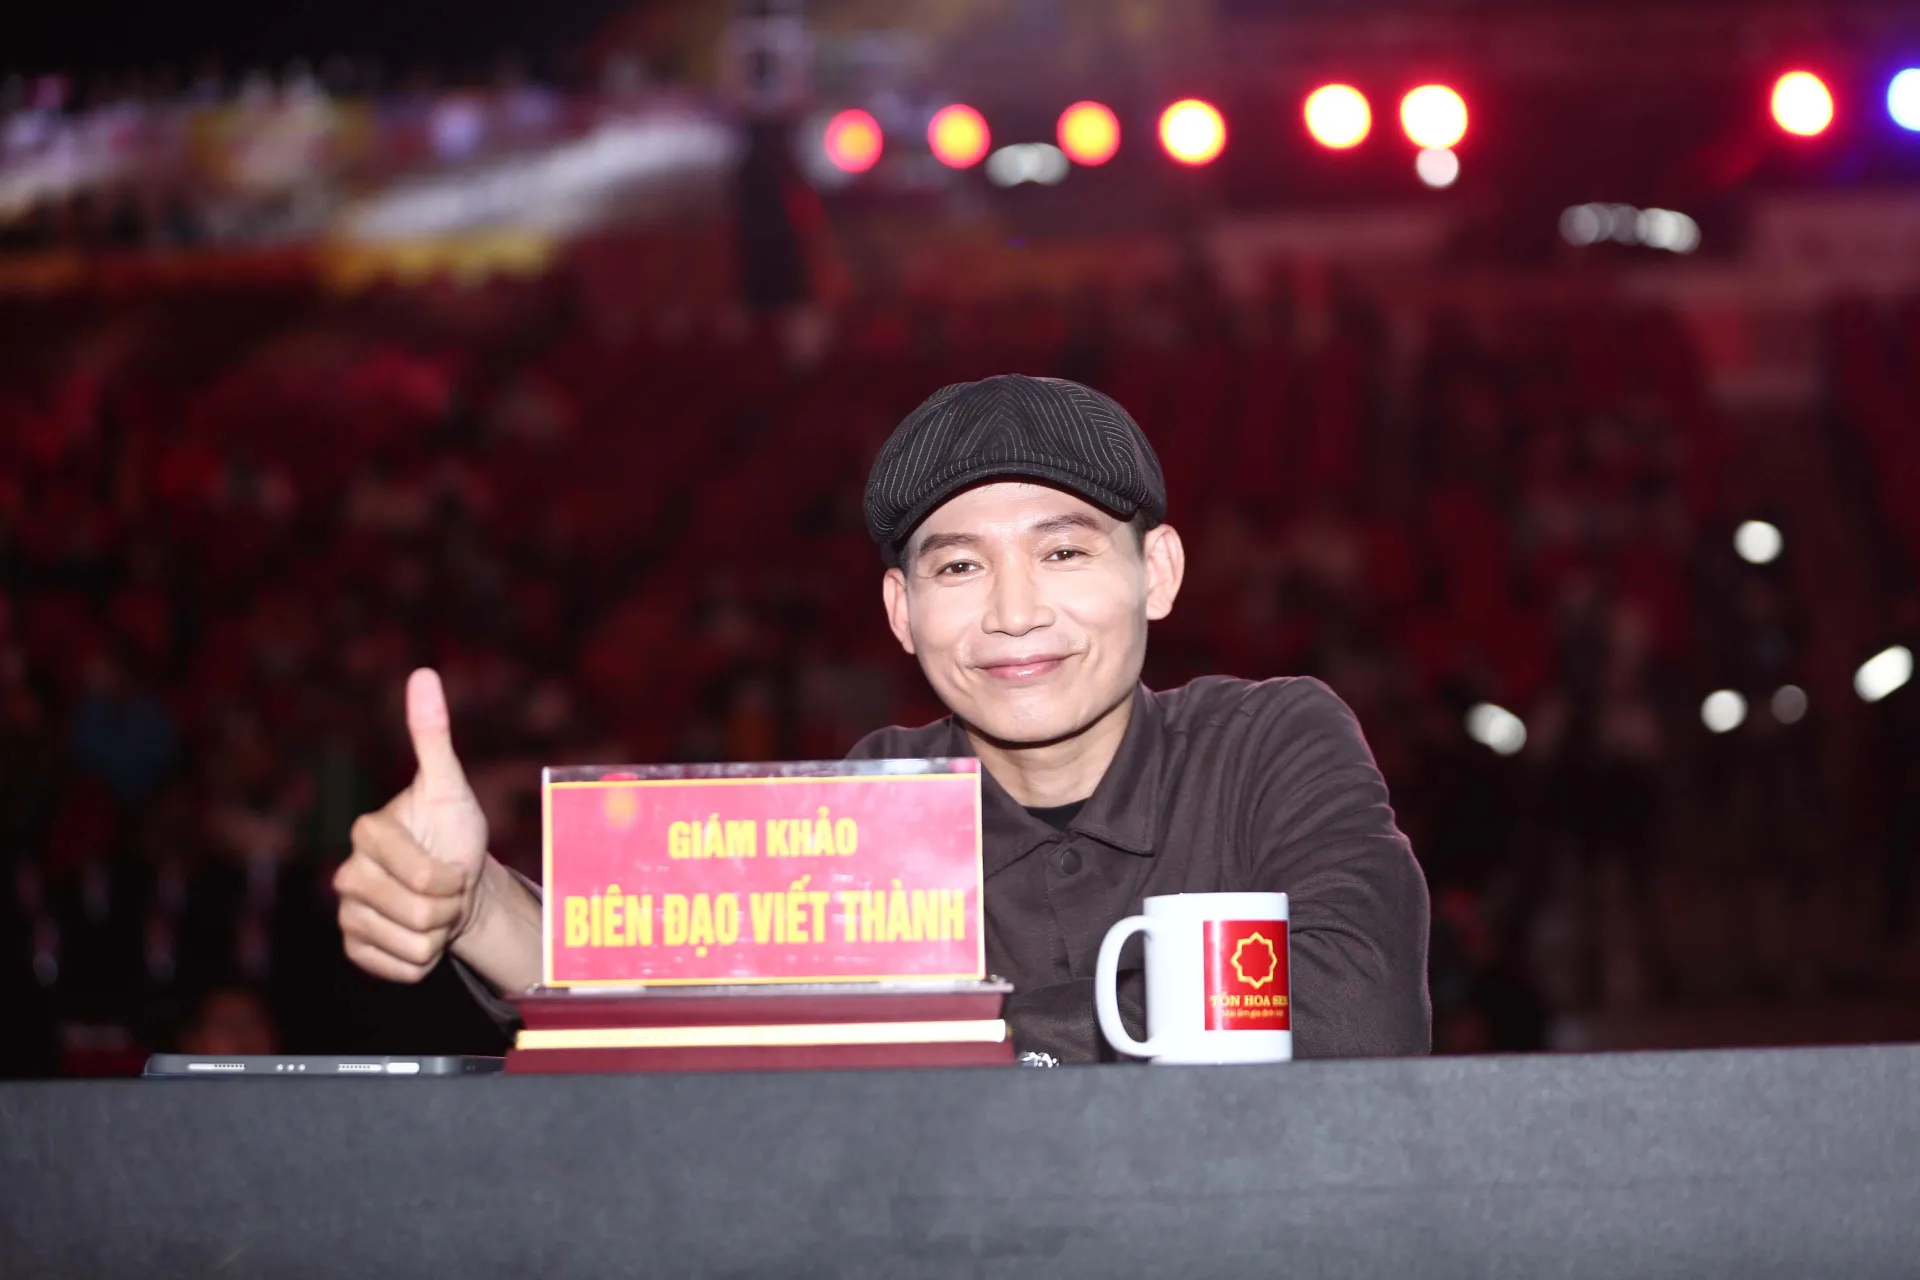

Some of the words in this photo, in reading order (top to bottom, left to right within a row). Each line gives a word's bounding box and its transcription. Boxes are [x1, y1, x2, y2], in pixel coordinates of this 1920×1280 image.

[668, 813, 757, 860] GIÁM
[766, 806, 858, 857] KHẢO
[565, 884, 653, 948] BIÊN
[663, 894, 740, 958] ĐẠO
[749, 875, 830, 944] VIẾT
[838, 878, 966, 942] THÀNH
[1244, 995, 1271, 1007] HOA
